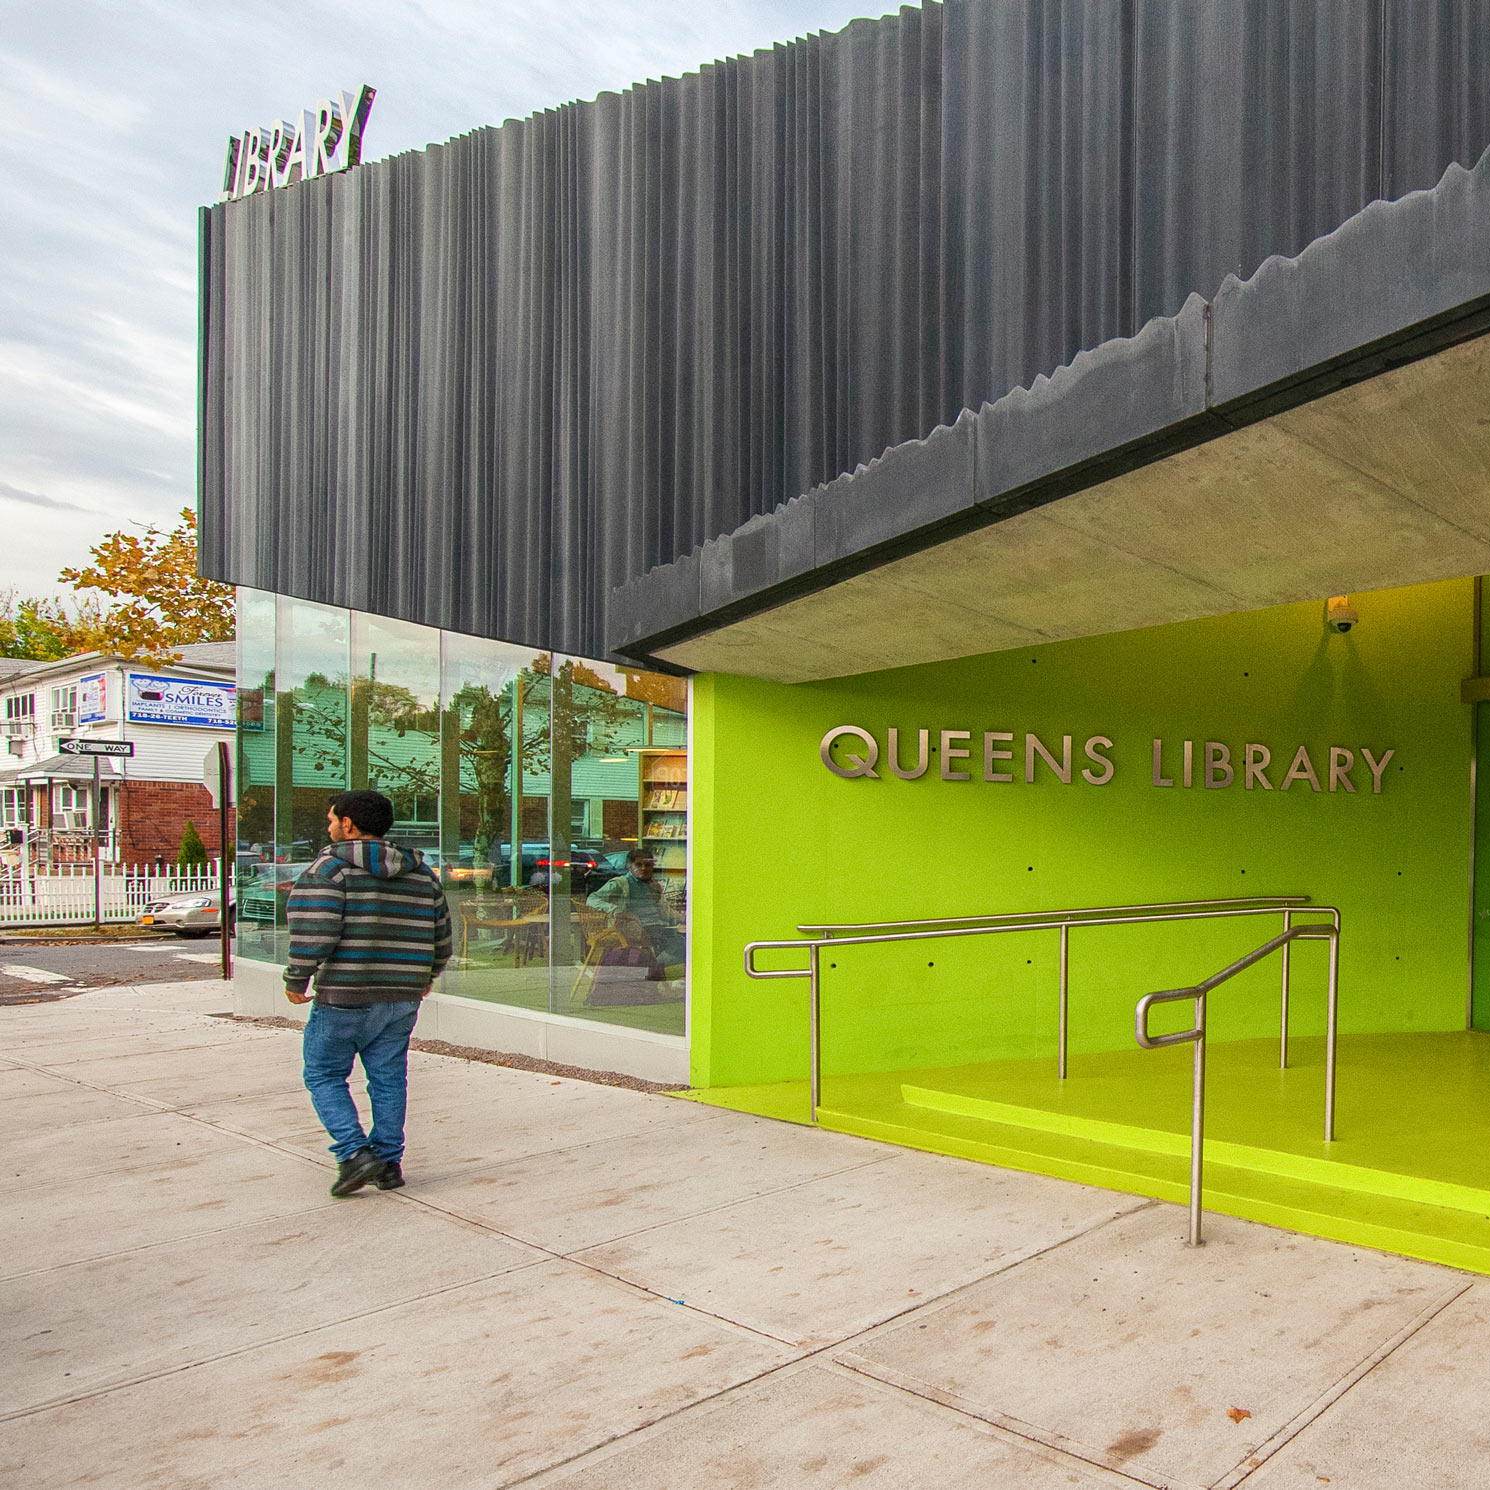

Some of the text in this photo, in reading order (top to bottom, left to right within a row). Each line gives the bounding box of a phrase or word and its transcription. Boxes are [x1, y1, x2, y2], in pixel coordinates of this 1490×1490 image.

[219, 83, 377, 203] LIBRARY
[165, 693, 223, 707] SMILES
[132, 701, 227, 714] IMPLANTS ORTHODONTICS
[67, 743, 128, 752] ONE WAY
[819, 724, 1396, 794] QUEENS LIBRARY
